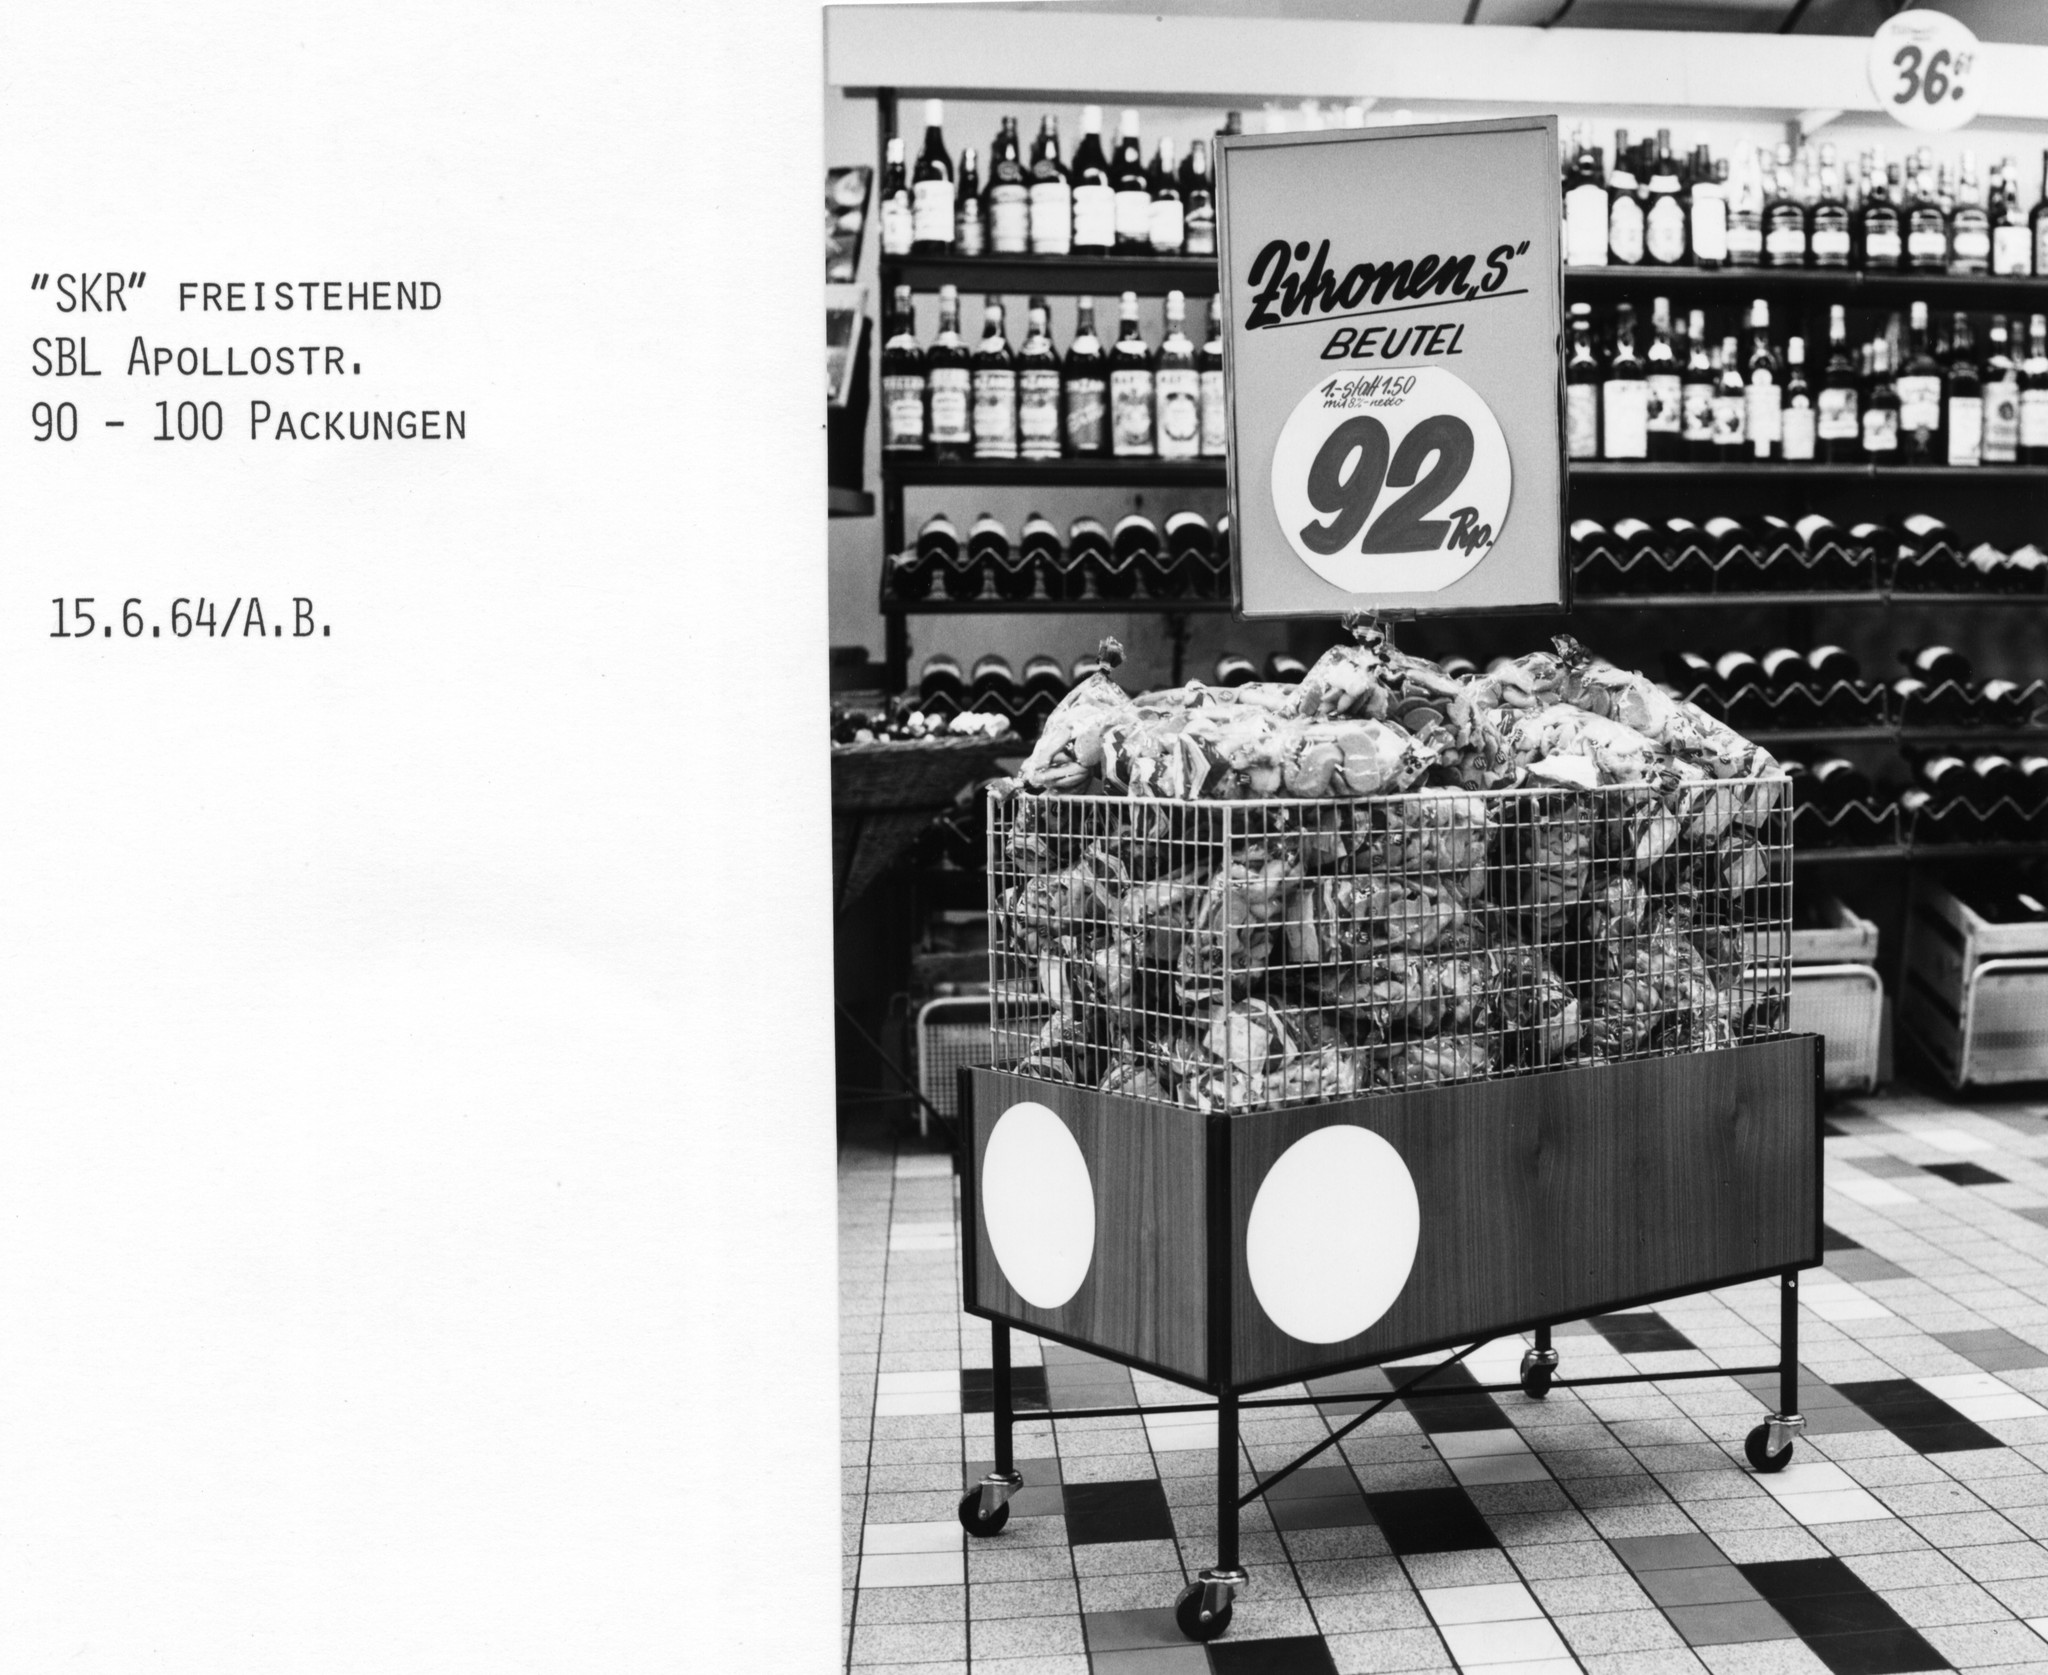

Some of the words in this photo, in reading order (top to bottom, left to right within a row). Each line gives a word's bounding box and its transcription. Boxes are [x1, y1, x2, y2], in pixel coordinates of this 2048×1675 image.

[179, 281, 442, 312] FREISTEHEND
[32, 336, 102, 376] SBL
[1320, 323, 1465, 360] BEUTEL
[31, 401, 78, 441] 90
[153, 400, 223, 441] 100
[1300, 414, 1476, 556] 92
[1447, 506, 1493, 557] Rp.
[50, 596, 331, 638] 15.6.64/A.B.
